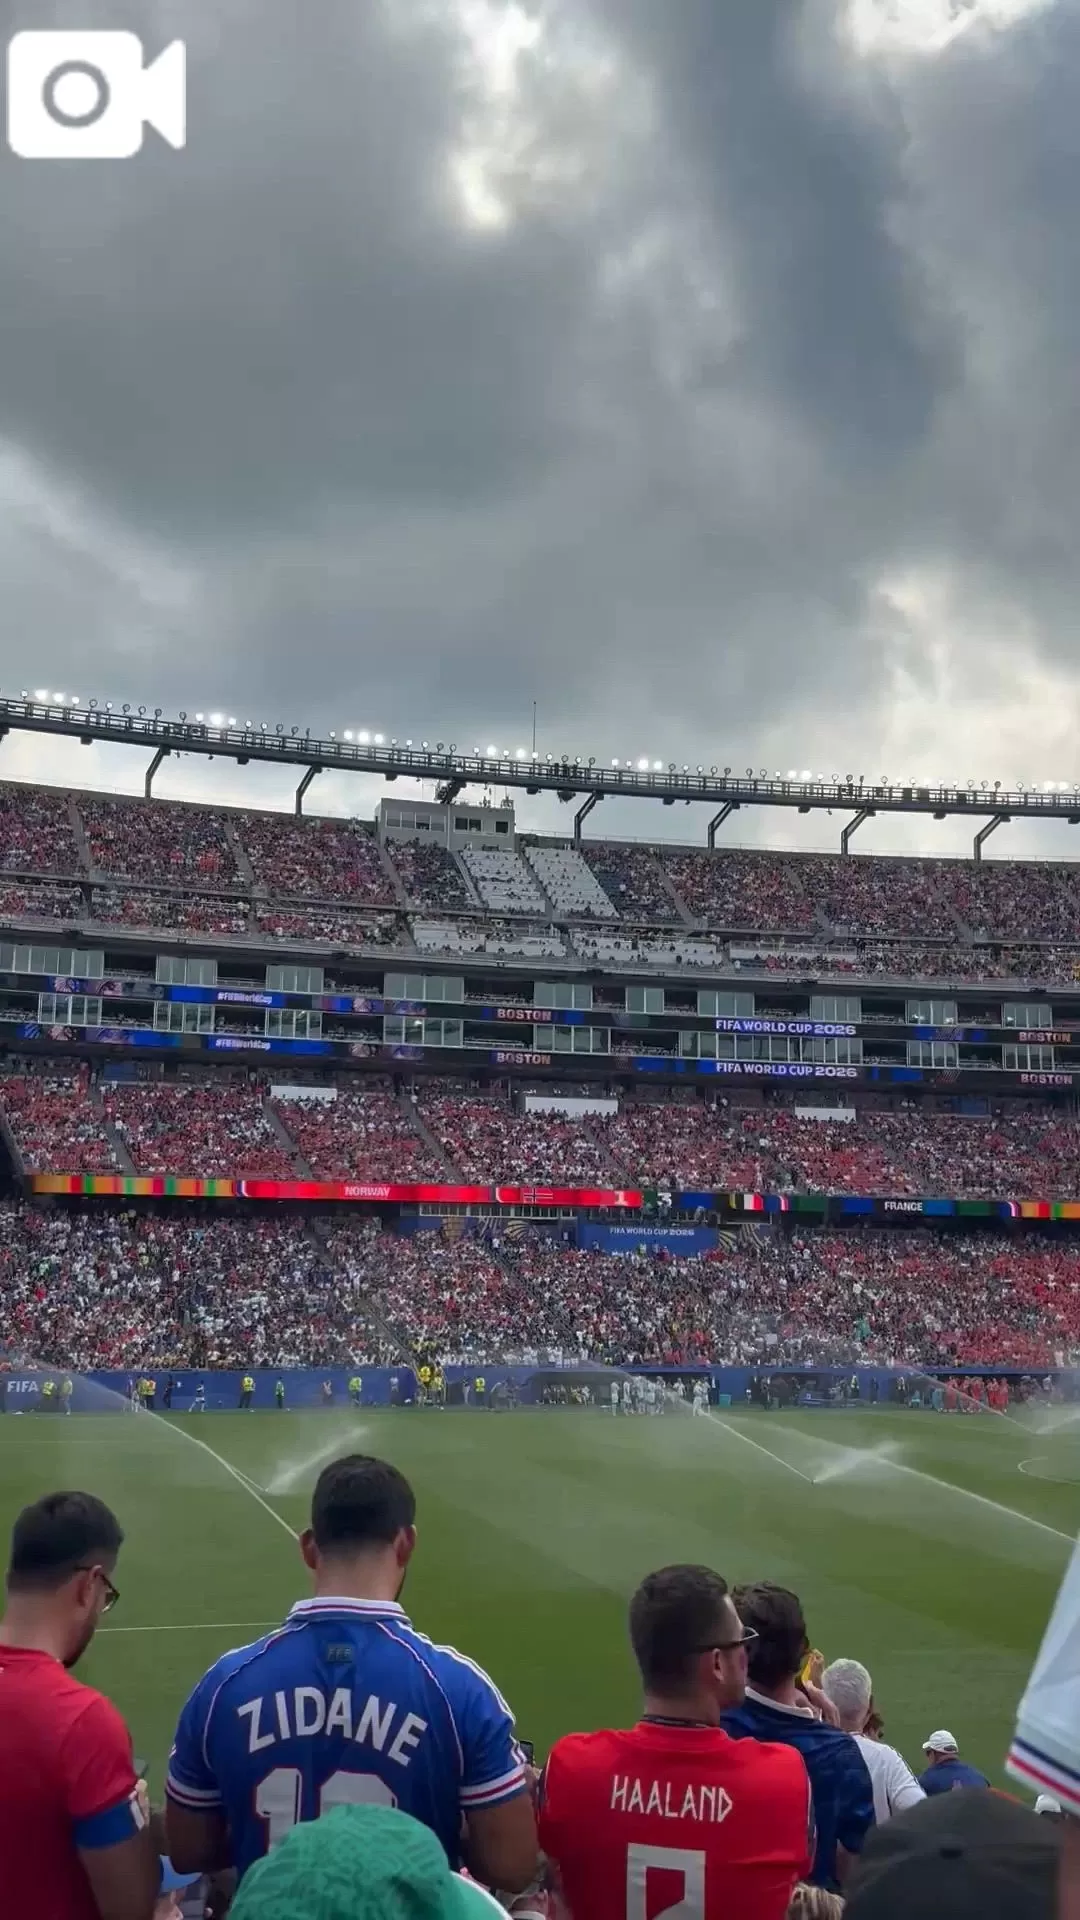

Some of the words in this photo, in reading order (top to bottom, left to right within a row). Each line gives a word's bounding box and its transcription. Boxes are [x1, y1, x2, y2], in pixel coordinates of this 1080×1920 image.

[497, 1008, 552, 1021] BOSTON
[716, 1020, 742, 1031] FIFA
[743, 1021, 786, 1033] WORLD
[788, 1023, 813, 1034] CUP
[814, 1024, 857, 1036] 2026
[1019, 1031, 1072, 1043] BOSTON
[496, 1052, 551, 1064] BOSTON
[716, 1062, 742, 1073] FIFA
[743, 1063, 787, 1075] WORLD
[788, 1065, 813, 1076] CUP
[815, 1067, 858, 1078] 2026
[1021, 1073, 1073, 1085] BOSTON
[344, 1186, 390, 1197] NORWAY
[884, 1201, 923, 1212] FRANCE
[610, 1227, 625, 1235] FIFA
[626, 1228, 653, 1236] WORLD
[653, 1229, 668, 1237] CUP
[669, 1229, 695, 1238] 2026
[7, 1380, 39, 1392] FIFA
[237, 1686, 429, 1768] ZIDANE
[610, 1775, 733, 1823] HAALAND
